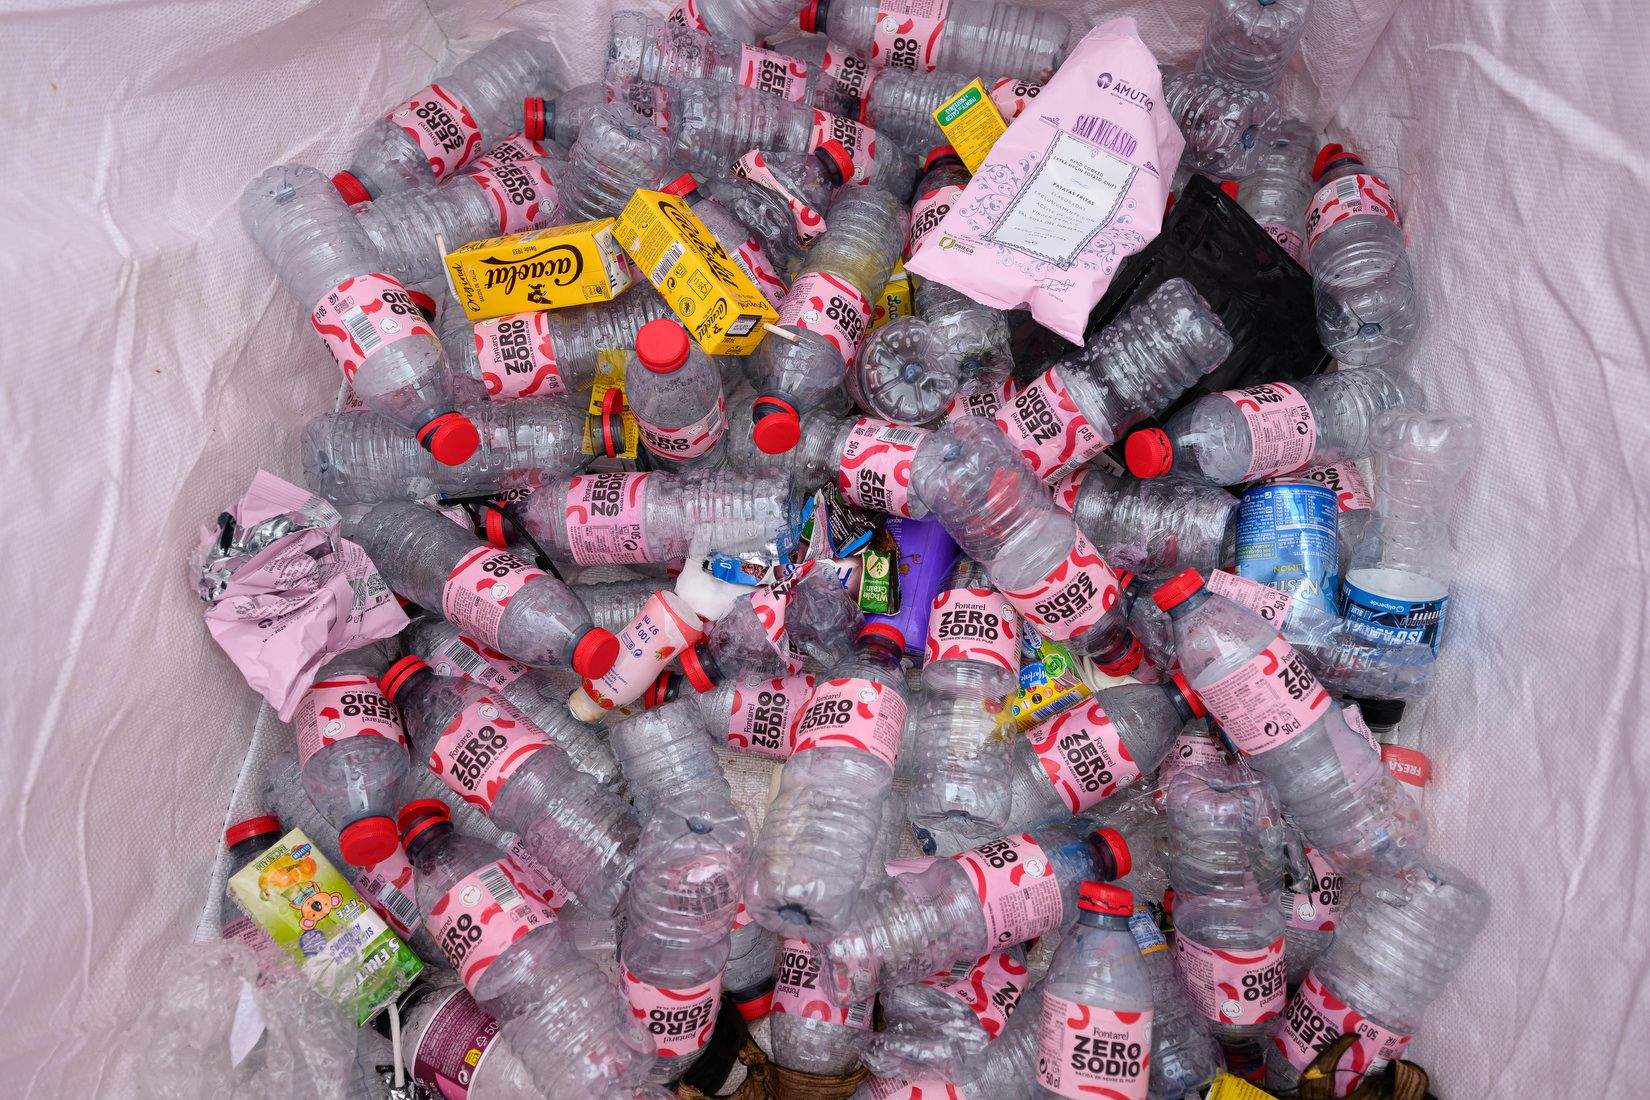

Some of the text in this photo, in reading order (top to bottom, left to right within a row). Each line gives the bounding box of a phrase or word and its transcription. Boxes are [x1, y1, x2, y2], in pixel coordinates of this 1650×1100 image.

[906, 39, 918, 71] DIO
[762, 59, 774, 94] SOD
[771, 62, 788, 99] ZER
[850, 59, 867, 100] ODIO
[416, 108, 455, 154] ZERO
[418, 122, 439, 147] Fontarel
[425, 101, 464, 150] SODIO
[833, 115, 844, 143] SOD
[1072, 114, 1138, 158] SAN NICASIO
[497, 143, 525, 162] ZER
[490, 166, 524, 205] SODIO
[503, 164, 536, 201] ZERO
[520, 165, 538, 185] Fontarel
[1052, 182, 1095, 206] PATATAS FRITAS
[1370, 204, 1379, 212] 50
[485, 244, 583, 295] Cacaolat
[453, 262, 481, 312] Original
[492, 334, 501, 363] Fontarel
[498, 322, 520, 376] ZERO
[516, 320, 535, 375] SODIO
[1015, 396, 1051, 446] ZERO
[1026, 386, 1062, 438] SODIO
[1301, 411, 1310, 420] 50
[1010, 413, 1029, 440] Fontarel
[1078, 426, 1095, 442] 50 cl
[849, 441, 859, 449] 50
[583, 480, 592, 502] Fontarel
[871, 470, 886, 510] ZER
[631, 531, 640, 540] 50
[863, 593, 888, 603] Whole
[865, 583, 888, 594] Grain
[1035, 571, 1088, 616] SODIO
[954, 602, 986, 610] Fontarel
[1044, 582, 1098, 624] ZERO
[1065, 603, 1093, 627] Fontarel
[1274, 594, 1290, 611] 50 cl
[650, 622, 660, 636] 97
[940, 610, 999, 628] ZERO
[637, 628, 651, 643] 100
[938, 624, 999, 641] SODIO
[508, 665, 518, 675] 50
[1278, 656, 1306, 687] ZER
[816, 692, 842, 703] Fontarel
[1288, 670, 1316, 701] SOD
[361, 717, 393, 729] Fontarel
[744, 703, 755, 733] Fontarel
[751, 692, 772, 747] ZERO
[766, 693, 787, 749] SODIO
[803, 700, 853, 720] ZERO
[799, 713, 851, 734] SODIO
[1281, 721, 1300, 735] 50 cl
[449, 729, 474, 760] Fontarel
[450, 725, 497, 783] ZERO
[1072, 729, 1114, 786] ZERO
[1094, 736, 1116, 767] Fontarel
[461, 734, 508, 791] SODIO
[1060, 737, 1100, 793] SODIO
[388, 937, 400, 951] 5
[441, 913, 473, 952] ERO
[451, 925, 482, 970] ODIO
[1243, 977, 1284, 1001] ERO
[650, 999, 713, 1020] SODIO
[649, 1016, 712, 1035] ZERO
[663, 1032, 696, 1043] Fontarel
[1093, 1027, 1129, 1040] Fontarel
[1358, 1023, 1378, 1040] 50 cl
[1073, 1034, 1141, 1060] ZERO
[1284, 1027, 1308, 1054] Fontarel
[1071, 1053, 1141, 1078] SODIO
[1046, 1076, 1060, 1089] 50 cl
